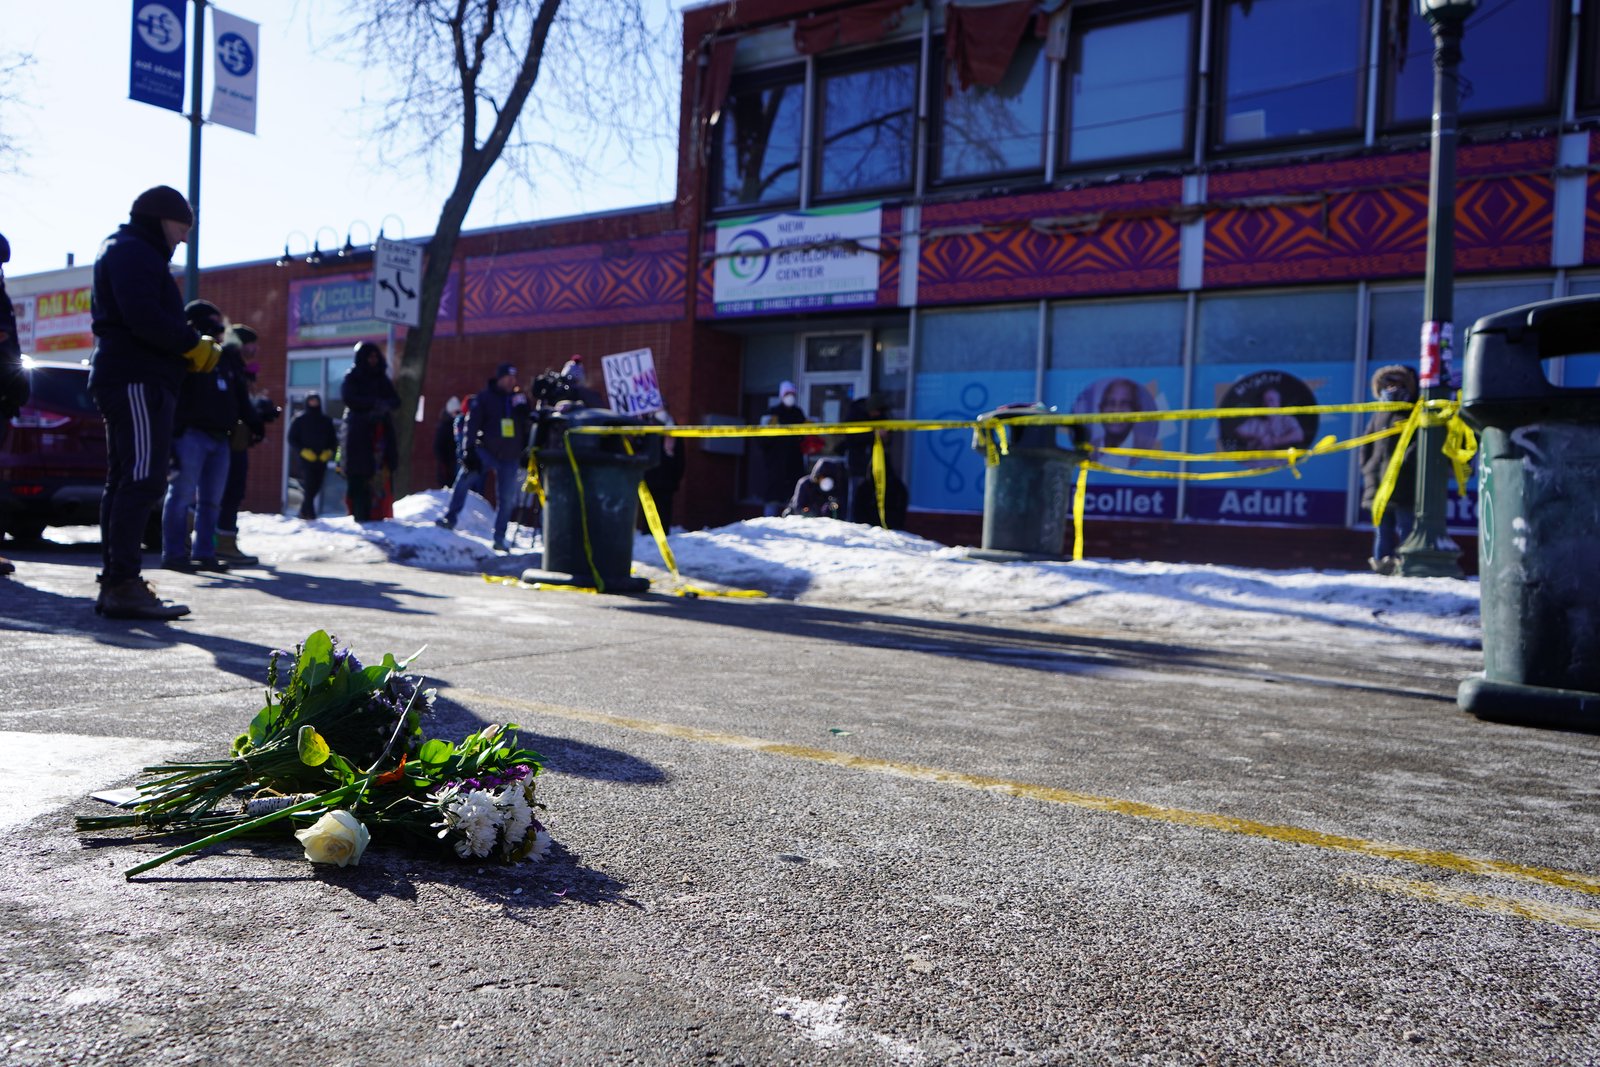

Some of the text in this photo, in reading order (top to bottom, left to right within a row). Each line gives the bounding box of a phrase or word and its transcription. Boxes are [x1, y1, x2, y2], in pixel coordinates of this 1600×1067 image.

[777, 220, 805, 233] NEW
[386, 252, 411, 266] LANE
[776, 265, 825, 281] CENTER
[312, 284, 373, 311] NICOLLE
[385, 308, 407, 320] ONLY
[606, 350, 647, 378] NOT
[611, 379, 630, 397] SO
[1073, 488, 1164, 514] collet
[1218, 489, 1308, 516] Adult
